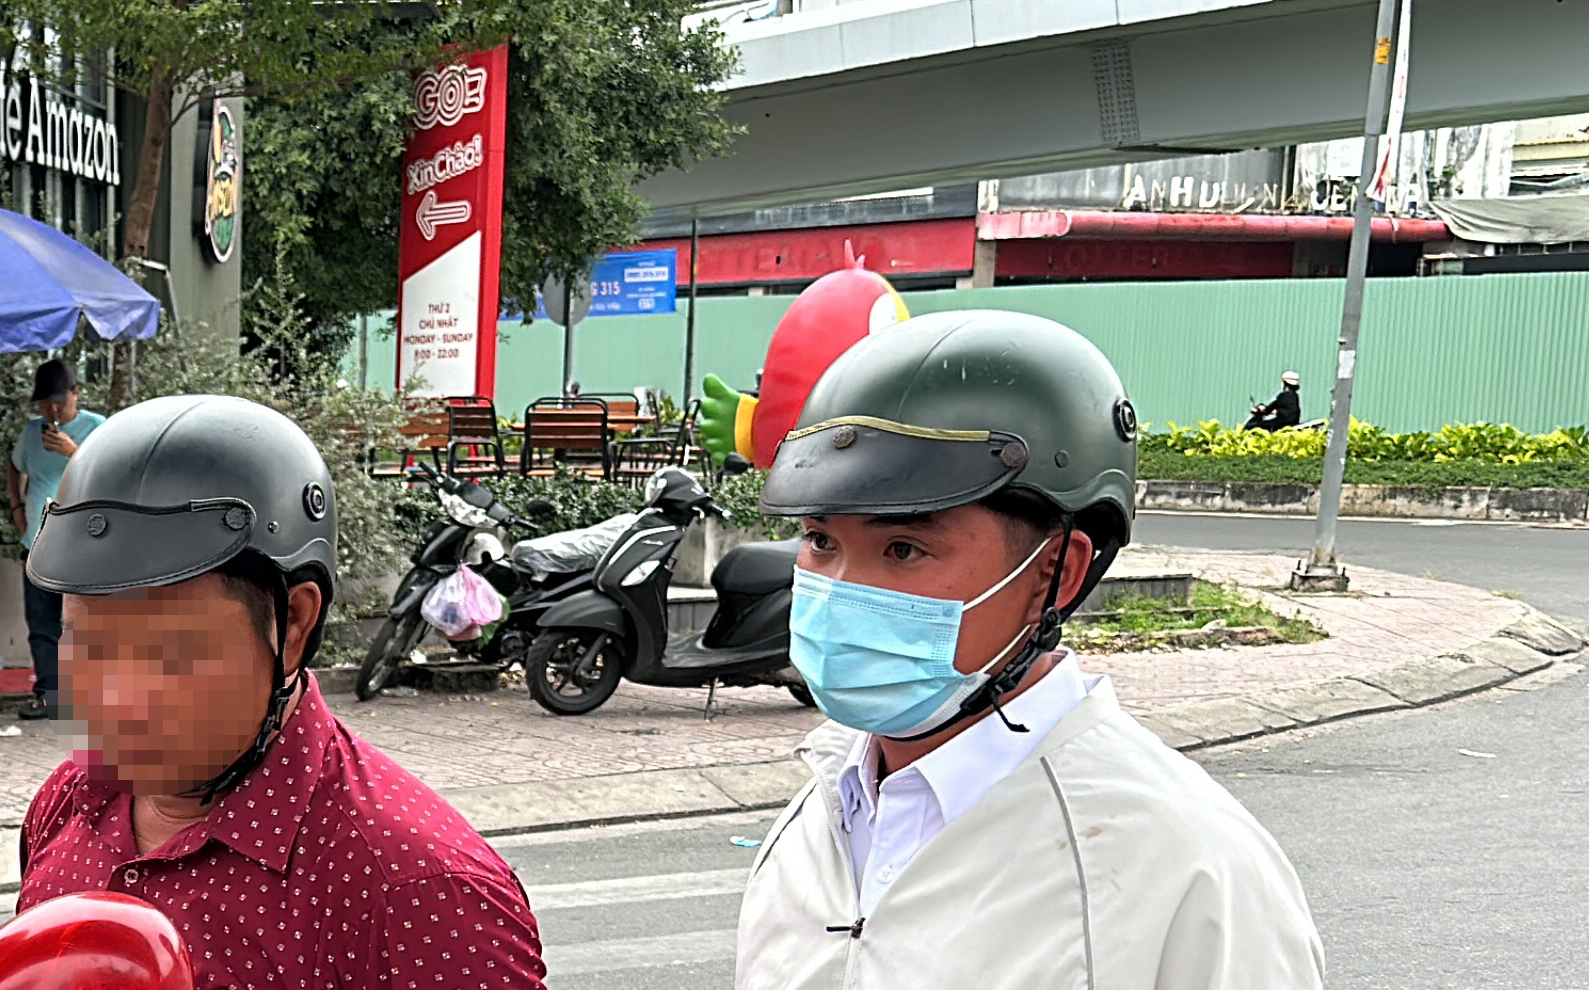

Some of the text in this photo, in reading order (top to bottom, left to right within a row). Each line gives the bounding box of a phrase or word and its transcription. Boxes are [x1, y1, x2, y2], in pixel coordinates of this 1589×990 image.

[25, 74, 120, 186] Amazon
[600, 281, 621, 297] 315
[404, 334, 435, 345] MONDAY
[442, 333, 473, 344] SUNDAY
